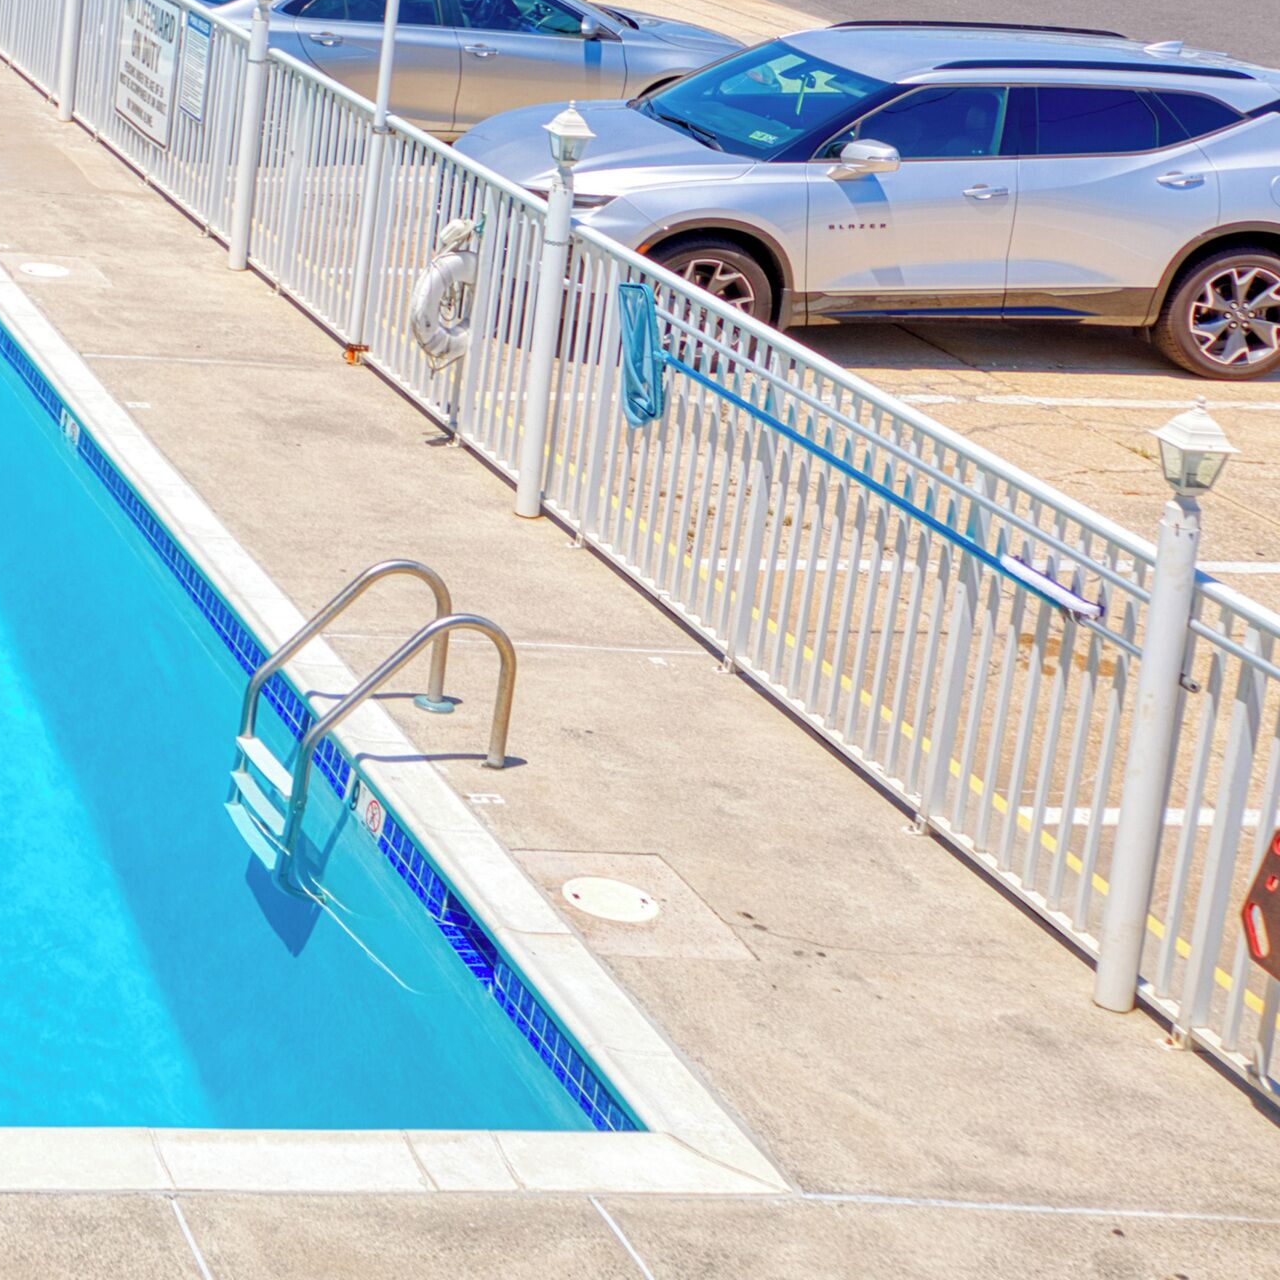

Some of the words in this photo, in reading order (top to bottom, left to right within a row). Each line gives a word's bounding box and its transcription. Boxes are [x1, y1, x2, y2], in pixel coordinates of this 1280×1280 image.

[131, 28, 142, 60] ON
[142, 35, 162, 74] DUTY
[350, 779, 361, 811] 9
